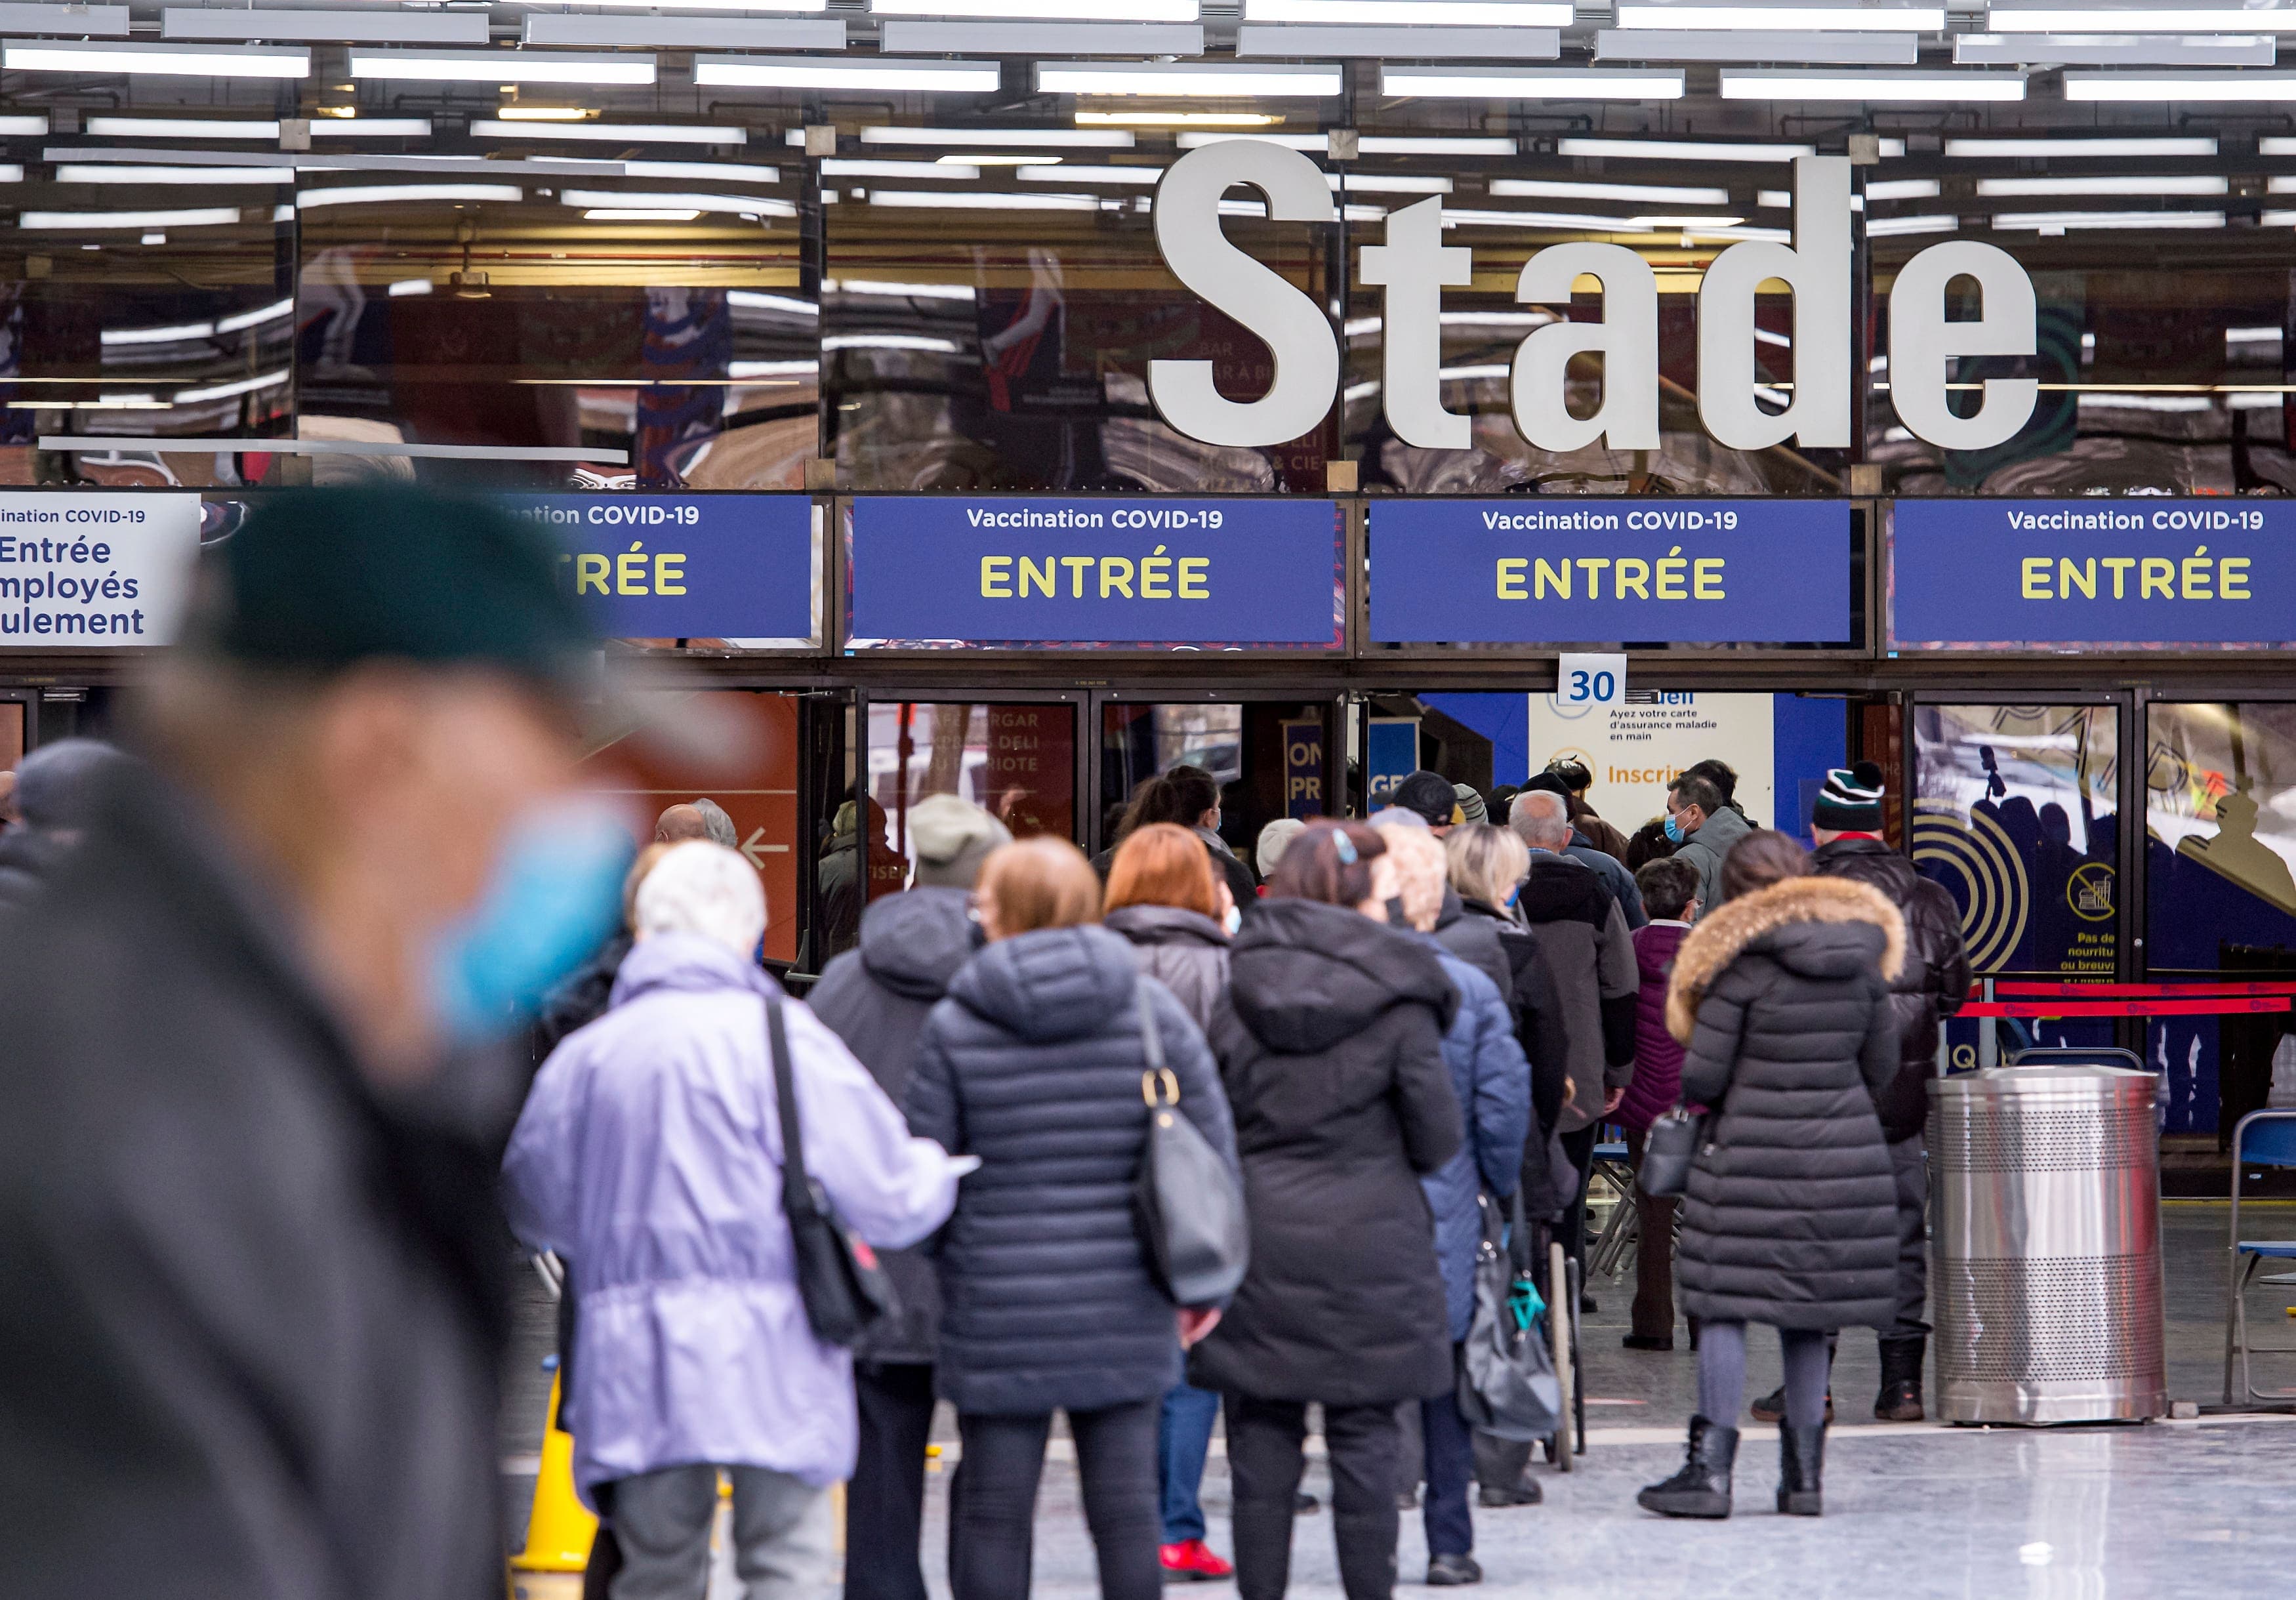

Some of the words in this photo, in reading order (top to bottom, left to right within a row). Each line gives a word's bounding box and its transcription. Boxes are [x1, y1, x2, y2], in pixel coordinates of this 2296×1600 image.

[1148, 139, 2038, 450] Stade
[1, 509, 60, 523] ination
[66, 510, 146, 523] COVID-19
[588, 505, 700, 525] COVID-19
[967, 508, 1103, 528] Vaccination
[1111, 508, 1223, 529] COVID-19
[1483, 510, 1618, 530] Vaccination
[1626, 510, 1738, 530] COVID-19
[2007, 510, 2143, 530] Vaccination
[2152, 510, 2264, 530] COVID-19
[0, 535, 110, 564] Entrée
[981, 545, 1210, 600] ENTRÉE
[1496, 546, 1725, 600] ENTRÉE
[2022, 545, 2251, 600] ENTRÉE
[1, 605, 144, 634] ulement
[1570, 670, 1615, 702] 30
[1609, 709, 1635, 720] Ayez
[1639, 710, 1667, 718] votre
[1670, 709, 1698, 718] carte
[1609, 720, 1672, 729] d'assurance
[1675, 720, 1717, 729] maladie
[1626, 731, 1652, 741] main
[2078, 932, 2098, 944] Pas
[2101, 932, 2115, 944] de
[2060, 961, 2075, 971] ou
